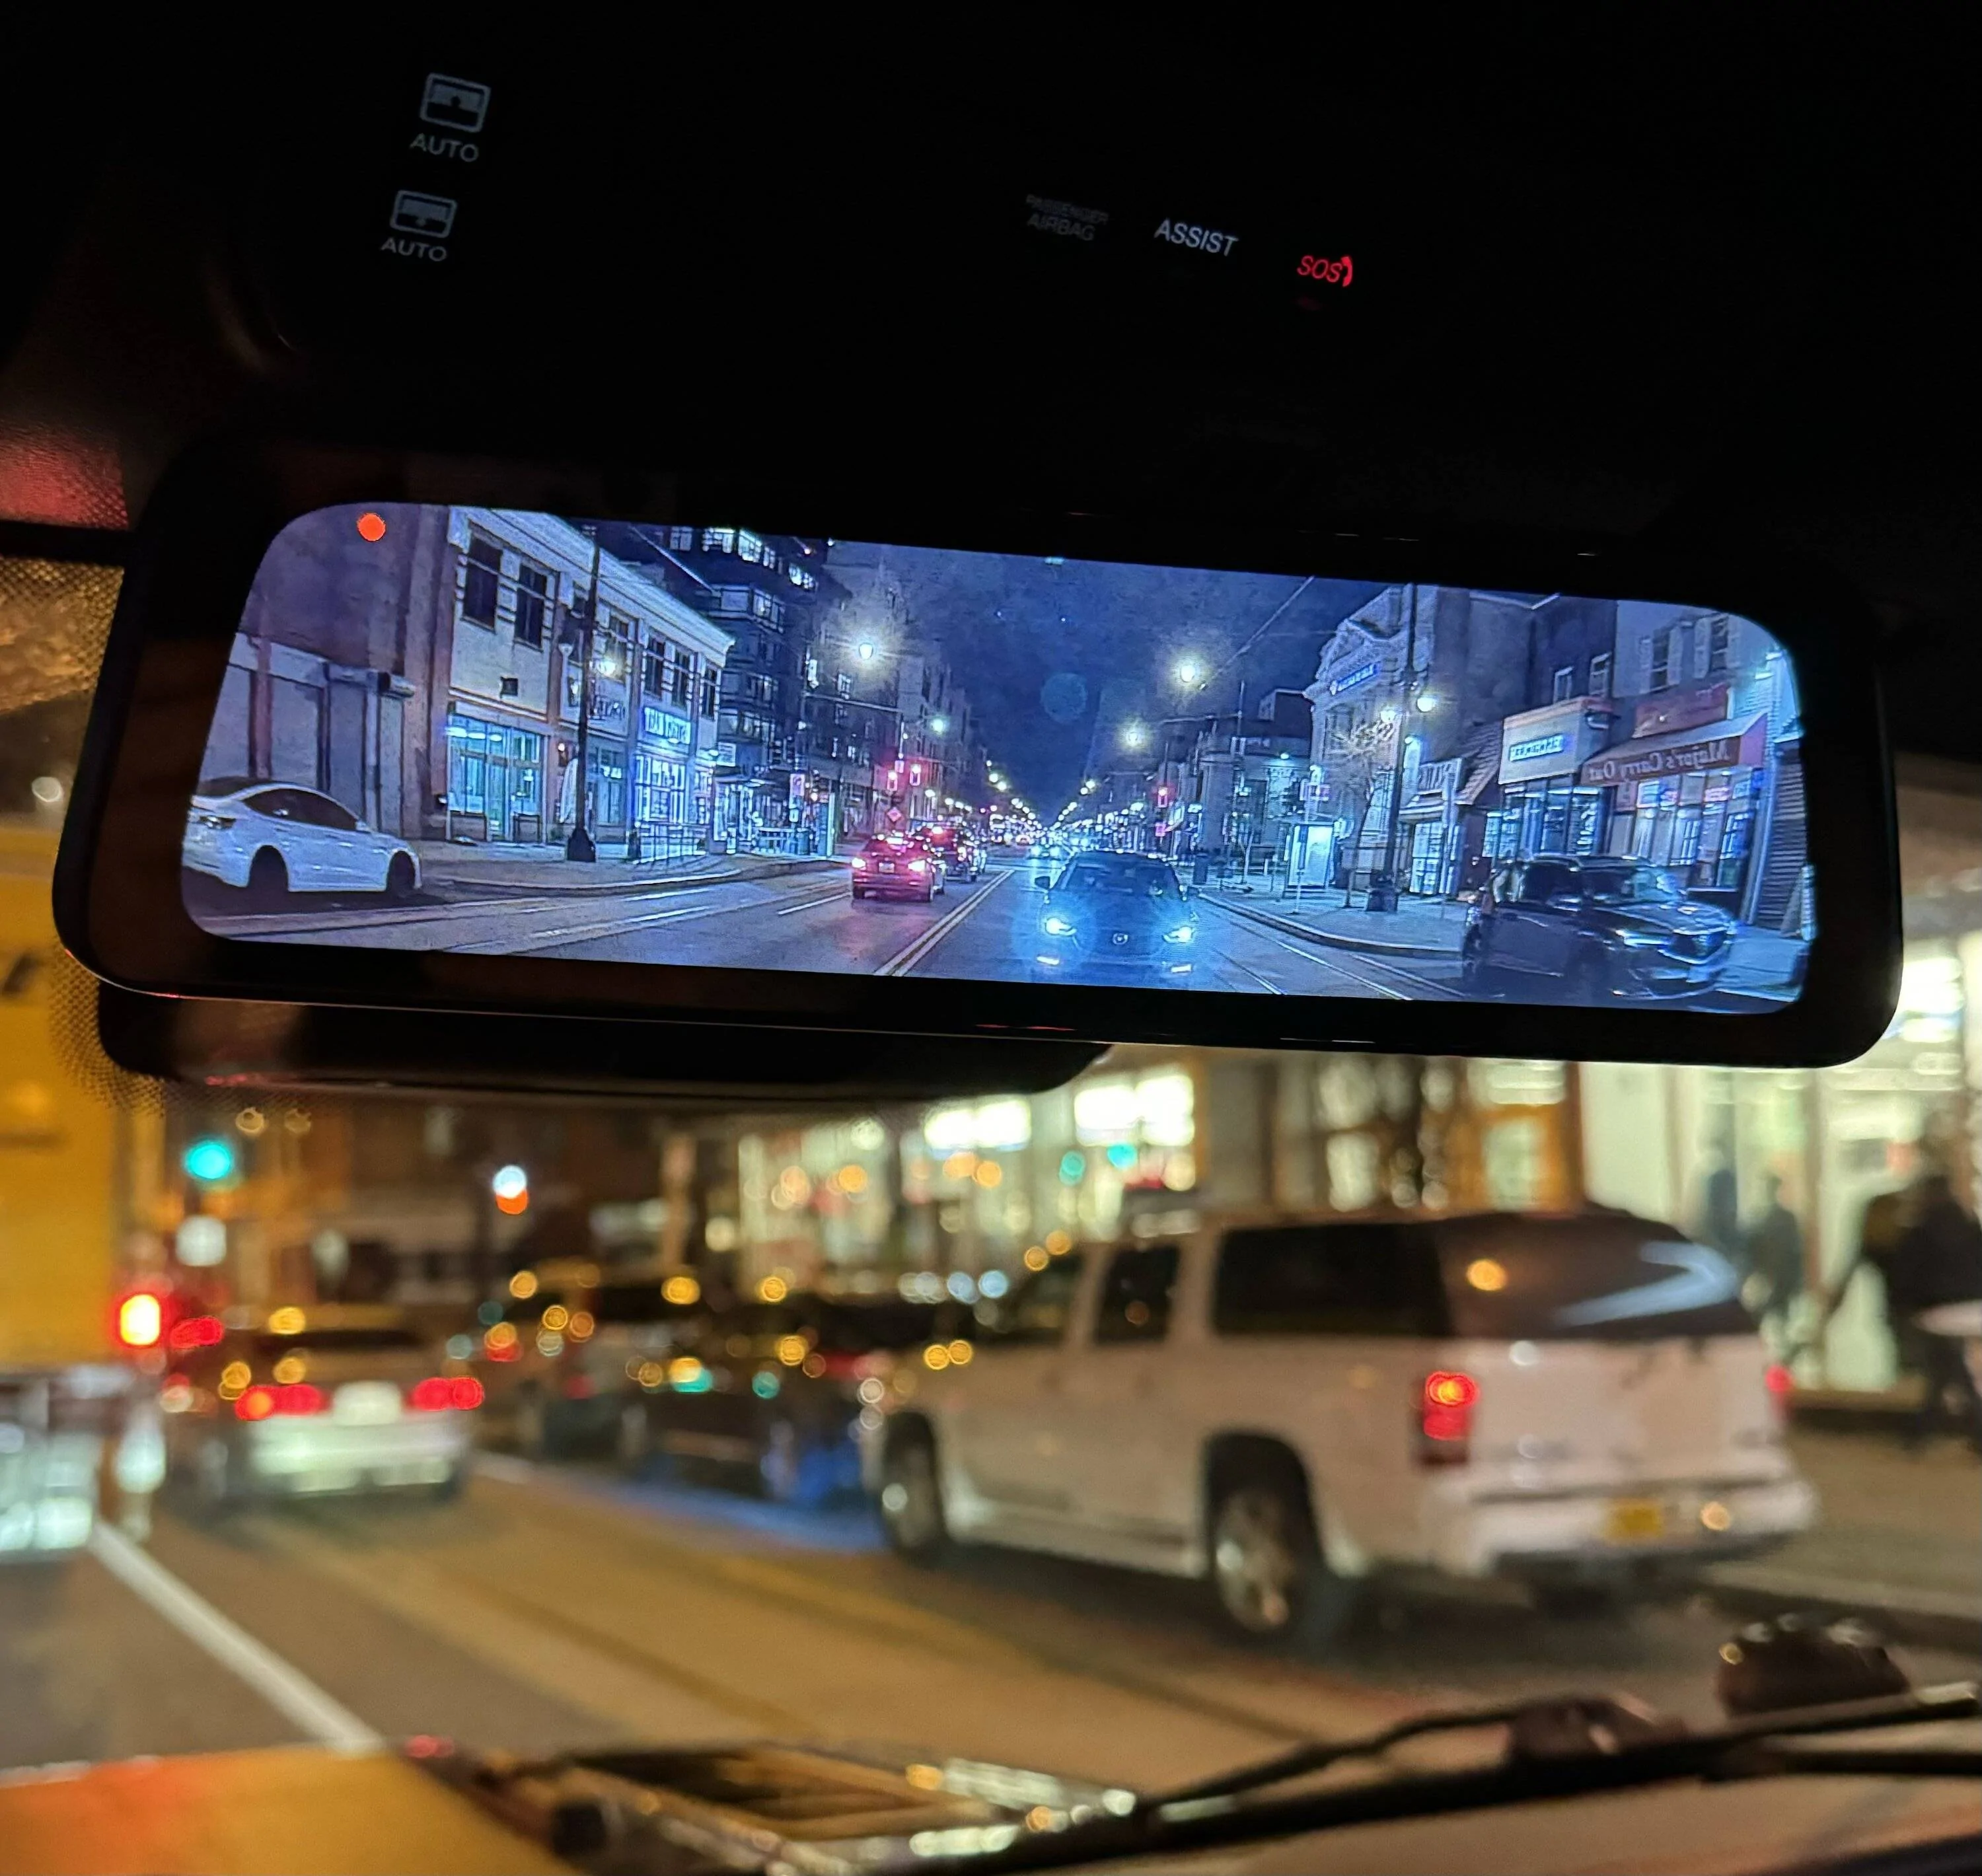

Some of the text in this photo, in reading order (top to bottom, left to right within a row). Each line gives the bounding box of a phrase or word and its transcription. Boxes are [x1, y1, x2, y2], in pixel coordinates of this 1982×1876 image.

[410, 133, 478, 162] AUTO
[1027, 213, 1096, 241] AIRBAG
[1154, 217, 1239, 257] ASSIST
[381, 237, 447, 261] AUTO
[1296, 255, 1342, 283] SOS
